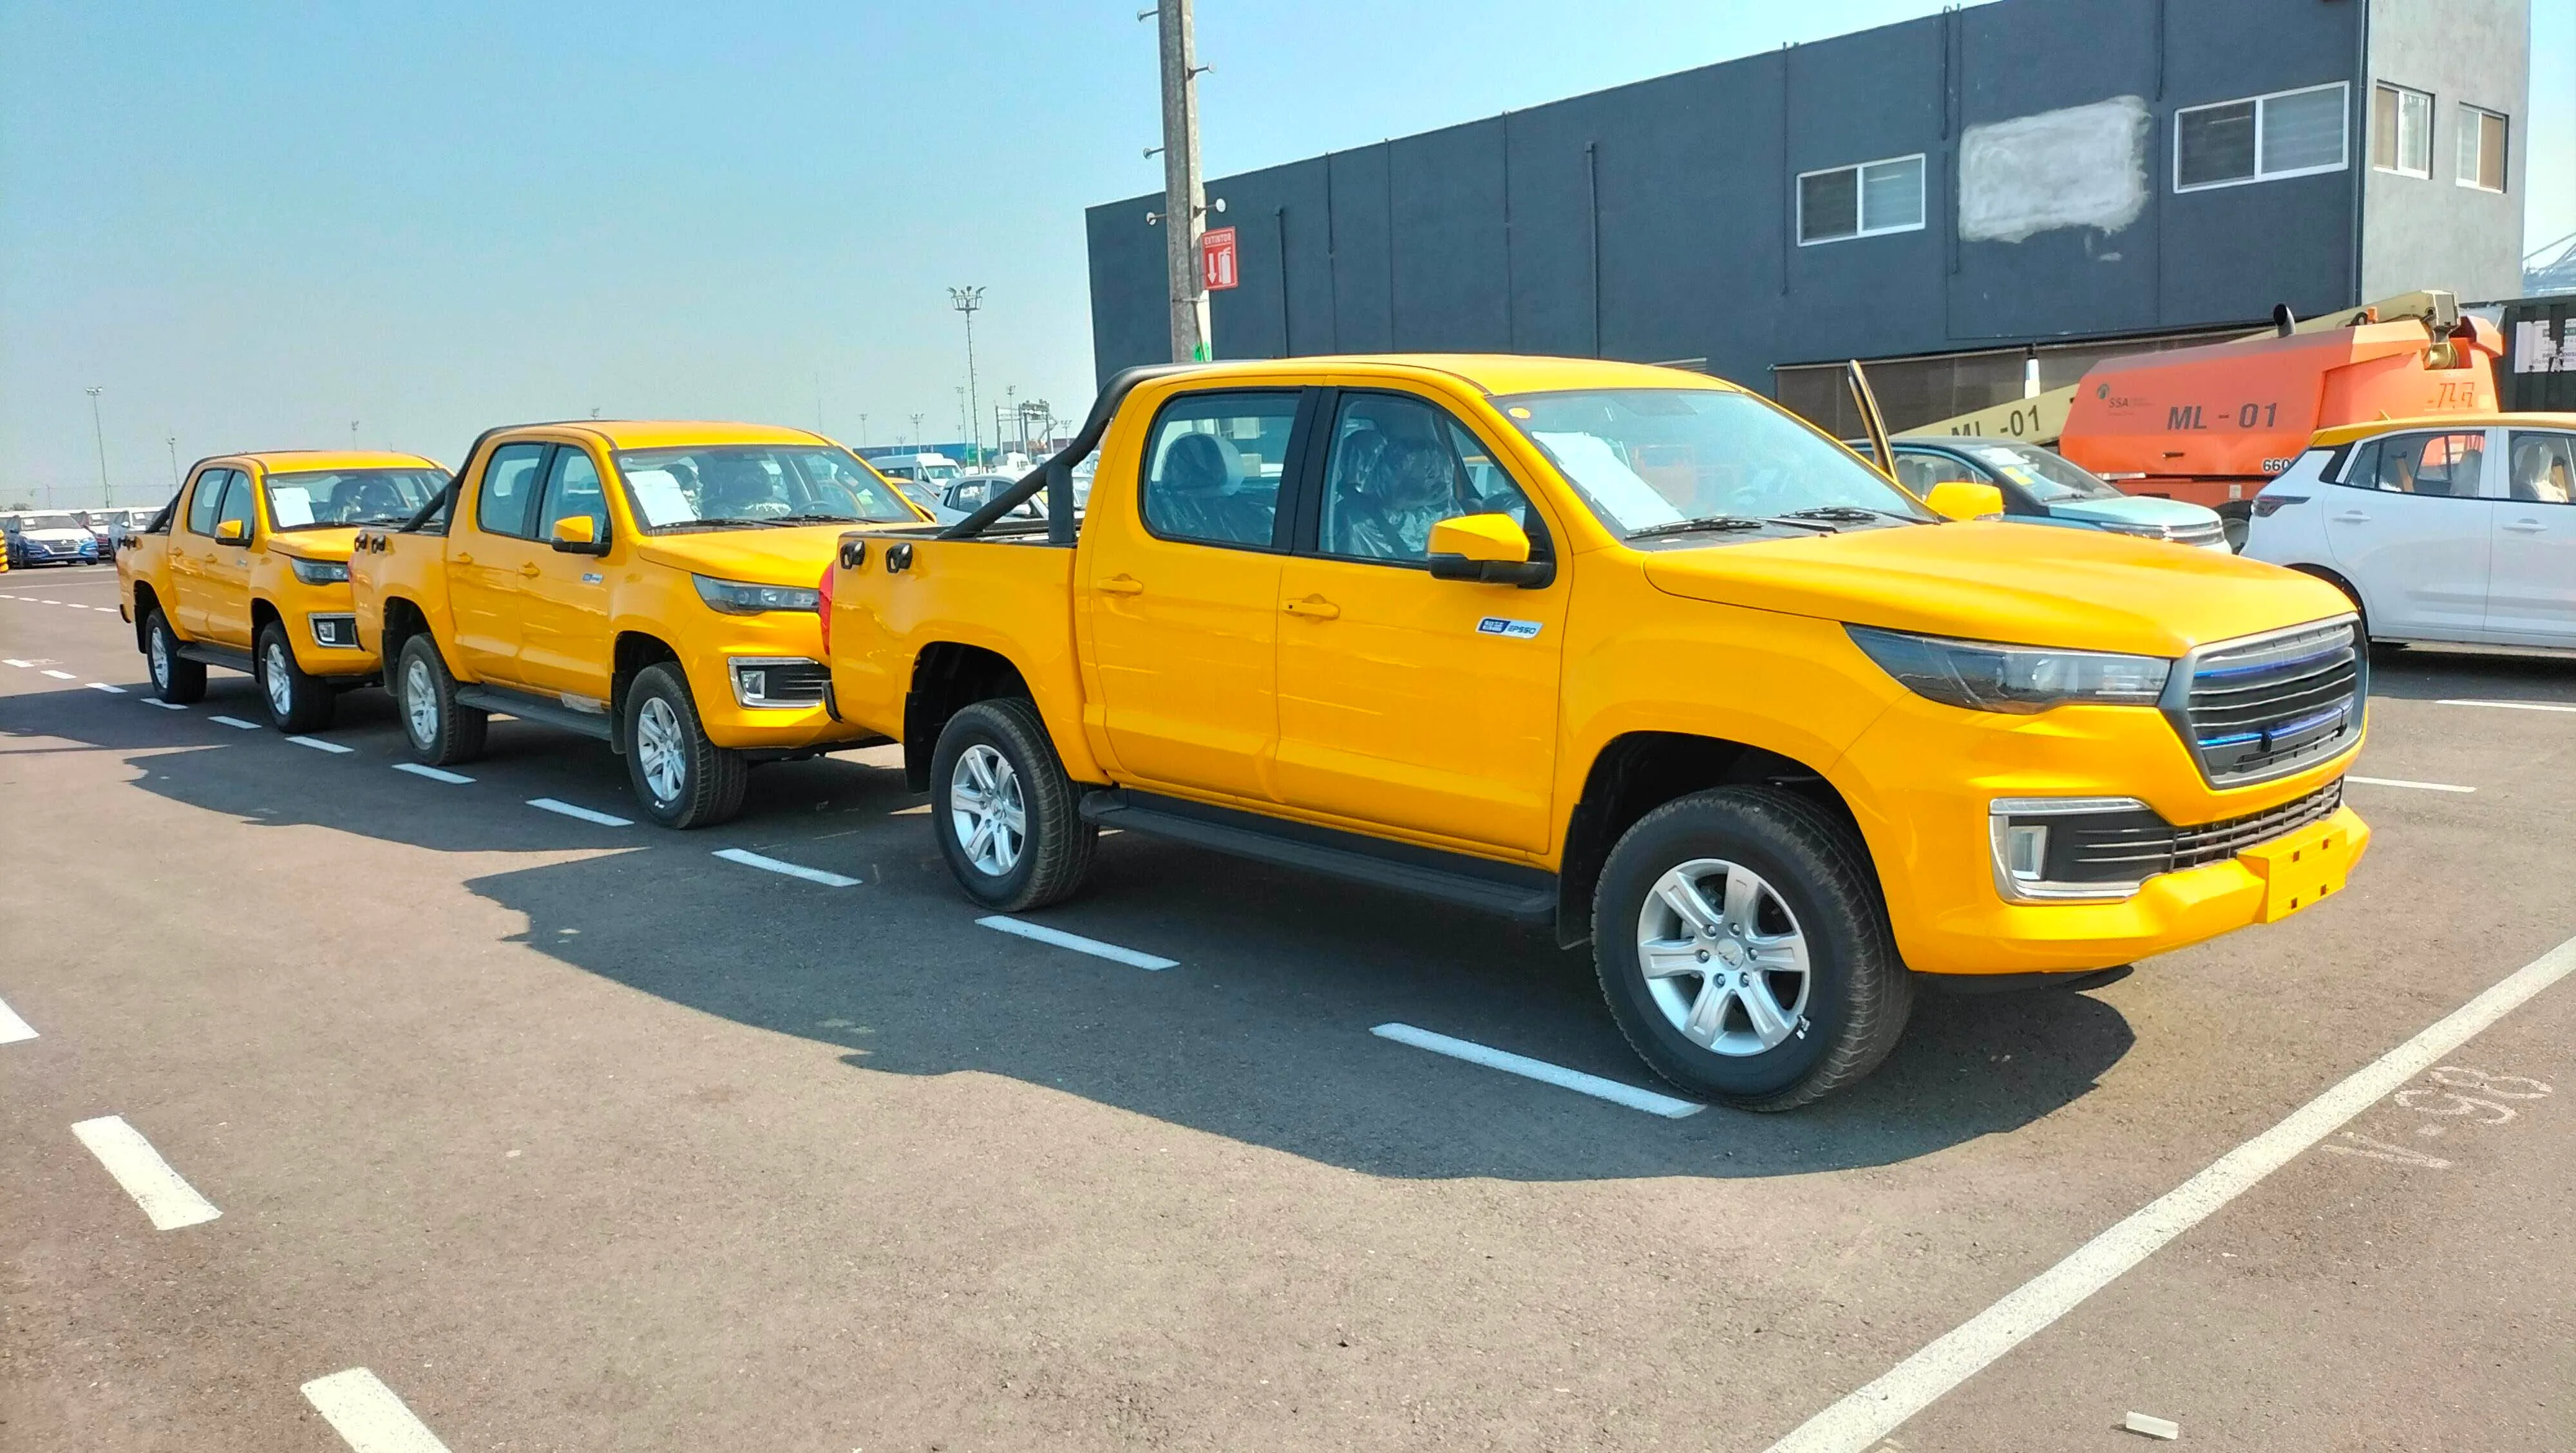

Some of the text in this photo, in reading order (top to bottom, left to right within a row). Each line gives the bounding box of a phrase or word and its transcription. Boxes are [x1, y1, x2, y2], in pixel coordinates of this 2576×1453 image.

[2108, 397, 2128, 408] SSA
[2166, 405, 2207, 430] ML
[2239, 402, 2278, 428] 01
[2262, 458, 2294, 472] 660
